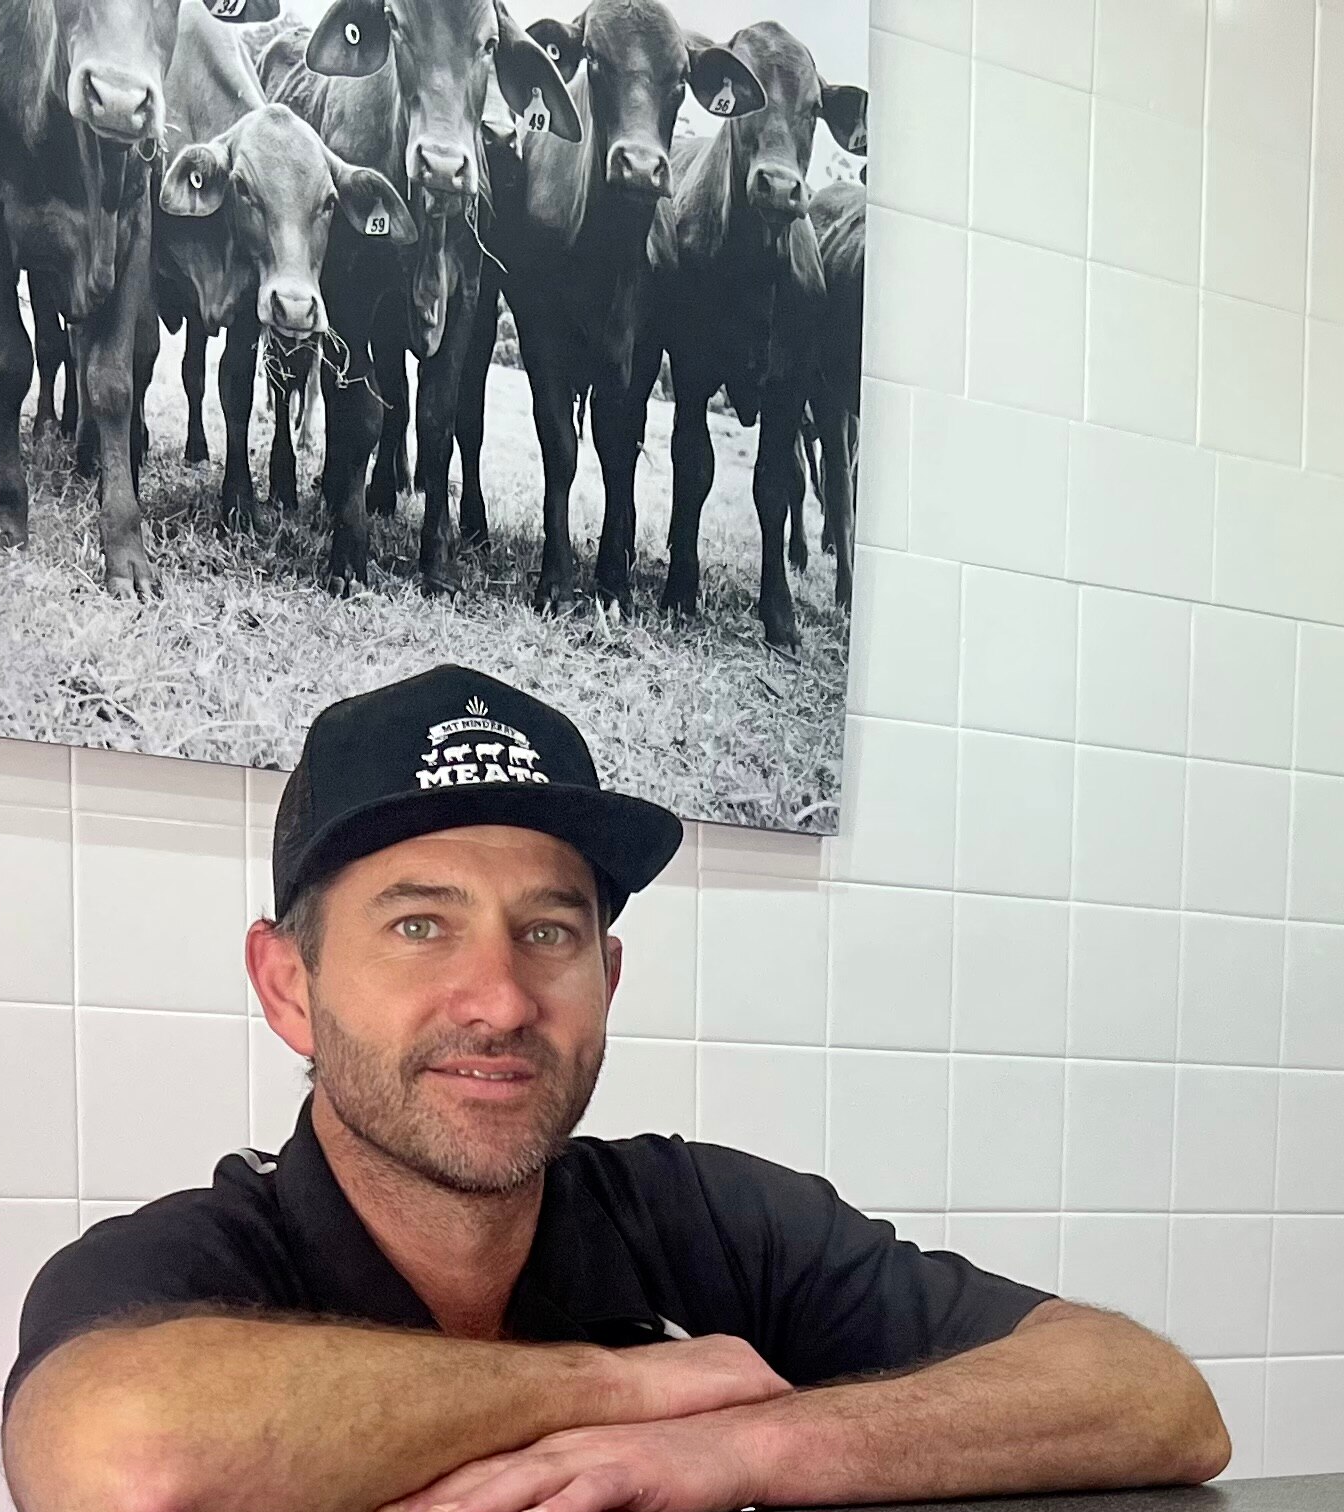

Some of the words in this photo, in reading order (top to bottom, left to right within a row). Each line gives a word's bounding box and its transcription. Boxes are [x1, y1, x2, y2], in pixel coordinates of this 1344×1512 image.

[715, 98, 730, 112] 56
[529, 113, 546, 130] 49
[371, 217, 385, 232] 59
[441, 723, 460, 733] MT
